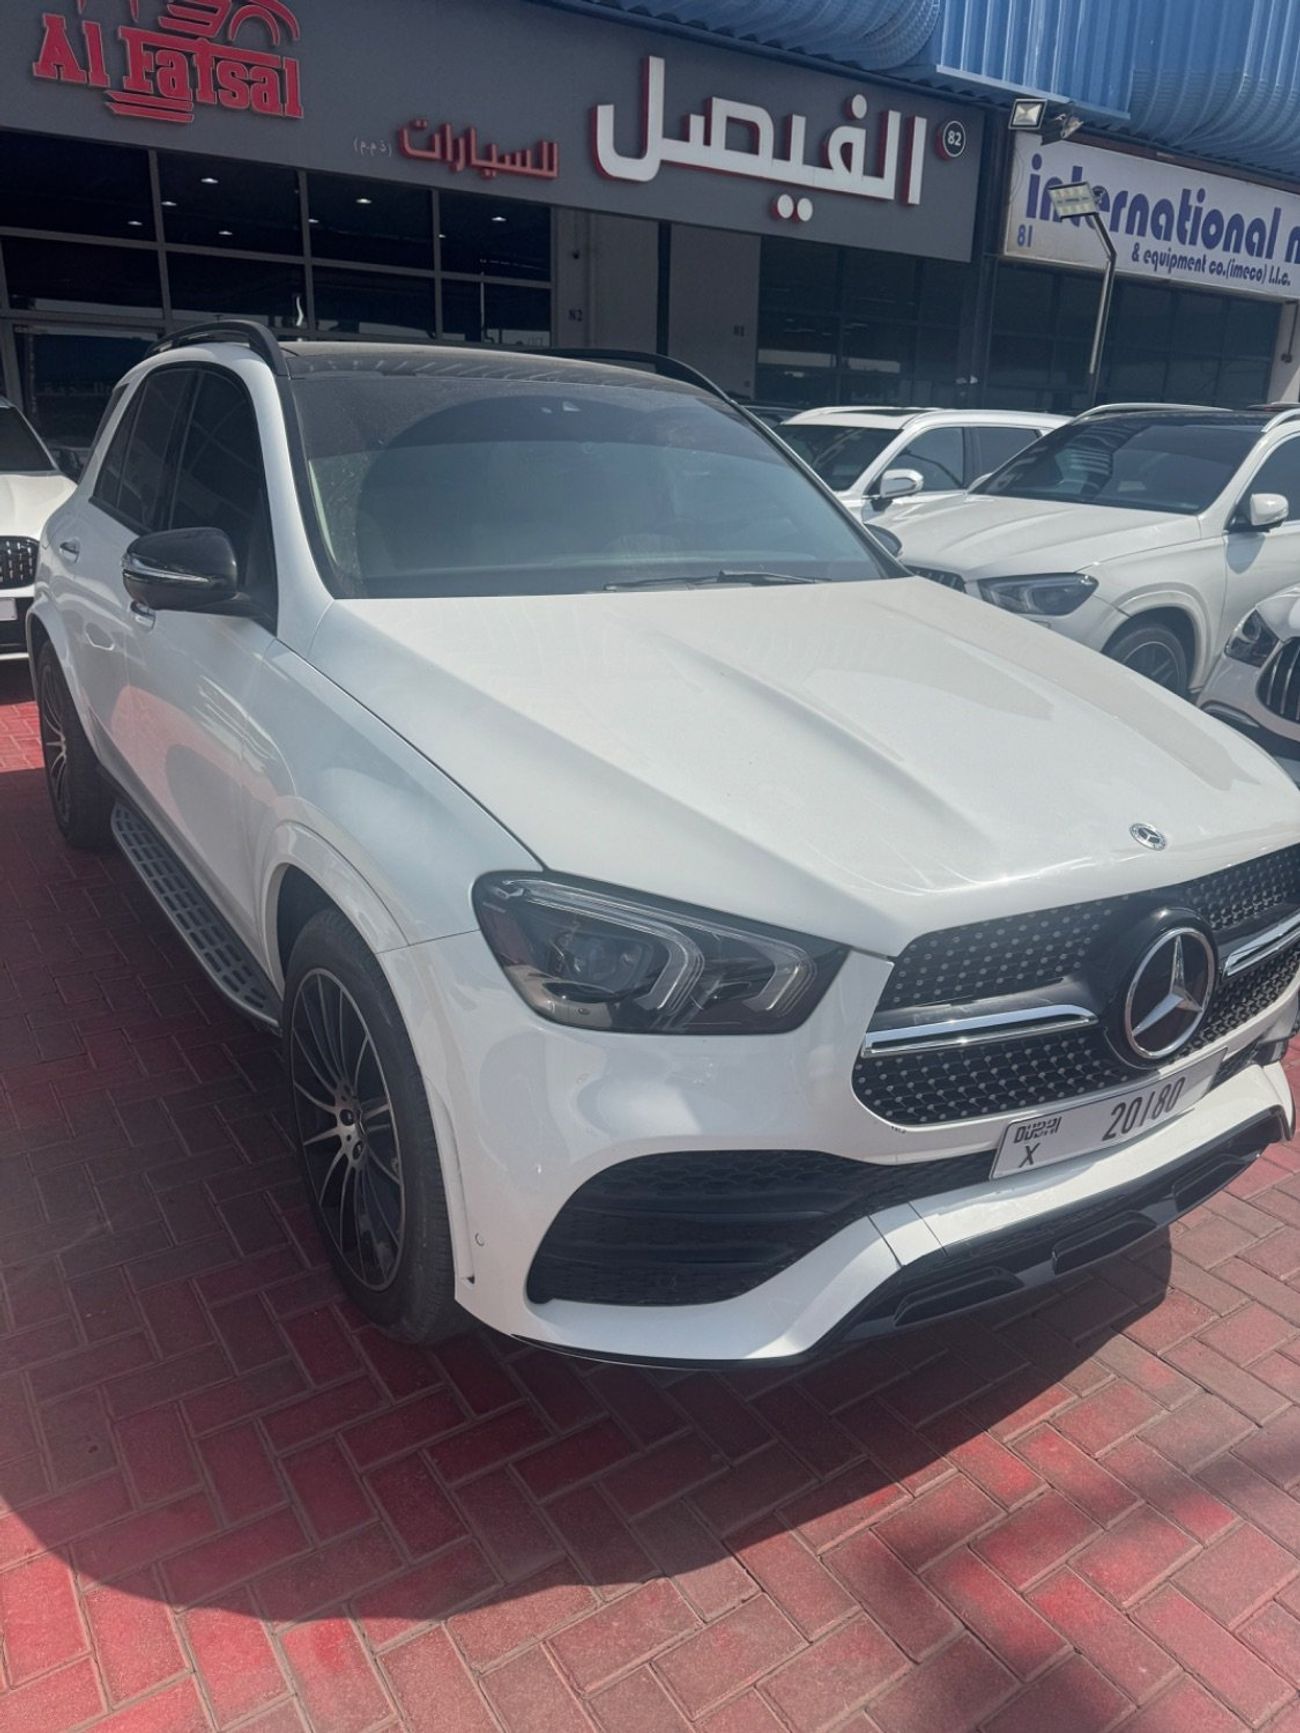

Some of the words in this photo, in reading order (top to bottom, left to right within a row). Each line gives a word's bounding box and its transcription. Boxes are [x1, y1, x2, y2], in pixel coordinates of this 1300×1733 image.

[33, 13, 110, 88] Al
[398, 118, 558, 179] للسيارات
[593, 55, 928, 222] الفيصل
[947, 130, 962, 146] 82
[1017, 223, 1033, 248] 81
[1131, 242, 1140, 262] &
[1143, 247, 1207, 274] equipment
[1102, 1076, 1187, 1142] 20180
[1018, 1142, 1041, 1169] X
